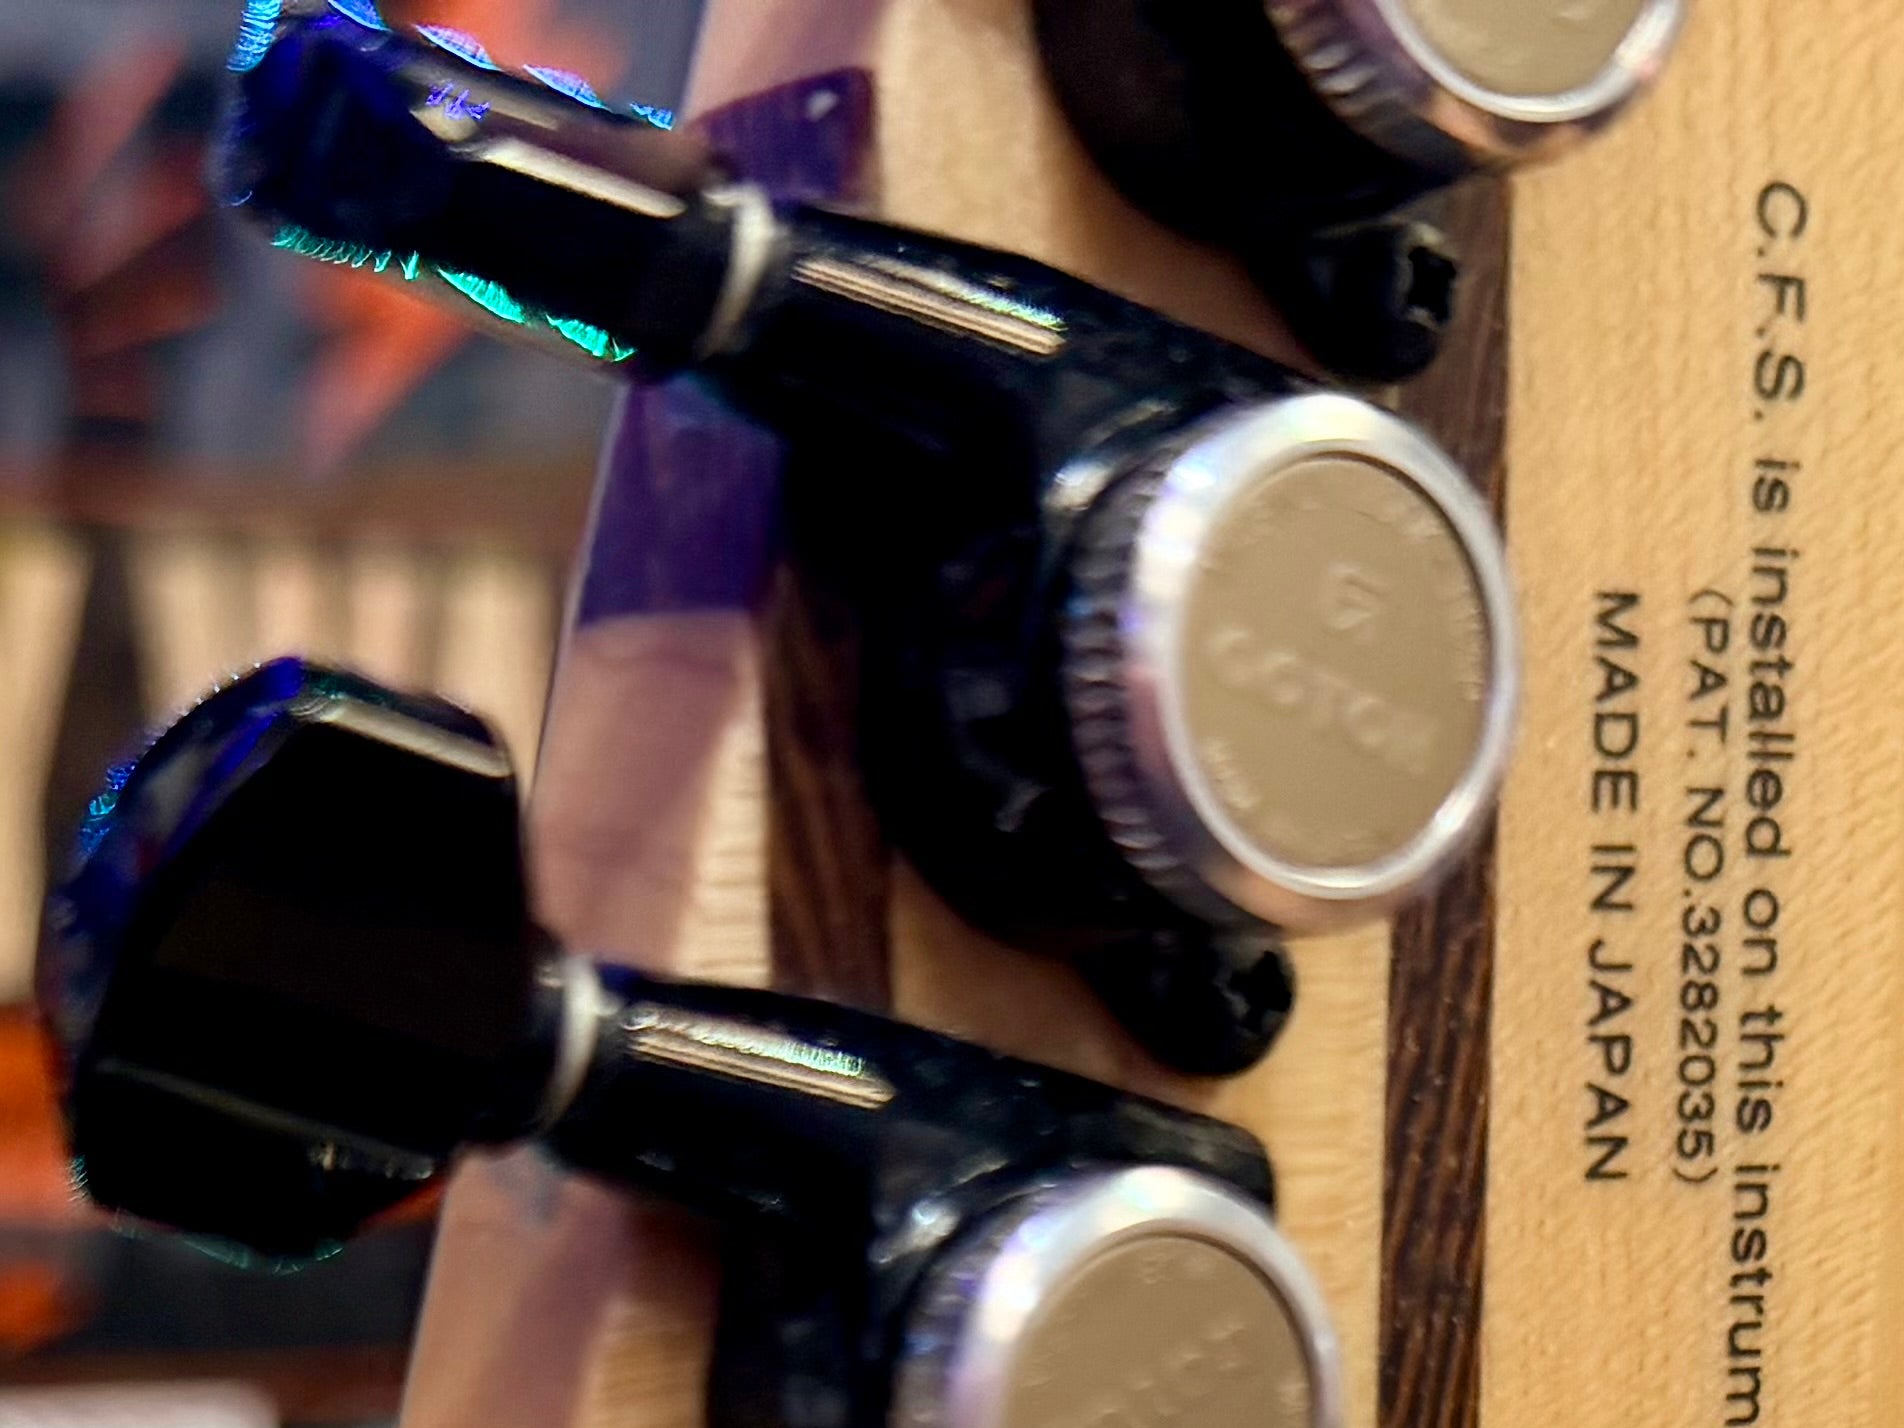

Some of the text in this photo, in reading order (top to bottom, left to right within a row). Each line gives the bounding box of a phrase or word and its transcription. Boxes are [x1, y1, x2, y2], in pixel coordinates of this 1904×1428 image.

[1752, 180, 1808, 422] C.F.S.
[1751, 457, 1802, 514] is
[1744, 546, 1800, 858] installed
[1584, 589, 1642, 1184] MADE IN JAPAN
[1671, 586, 1734, 1186] (PAT. NO.3282035)
[1740, 887, 1781, 978] on
[1736, 1003, 1786, 1133] this
